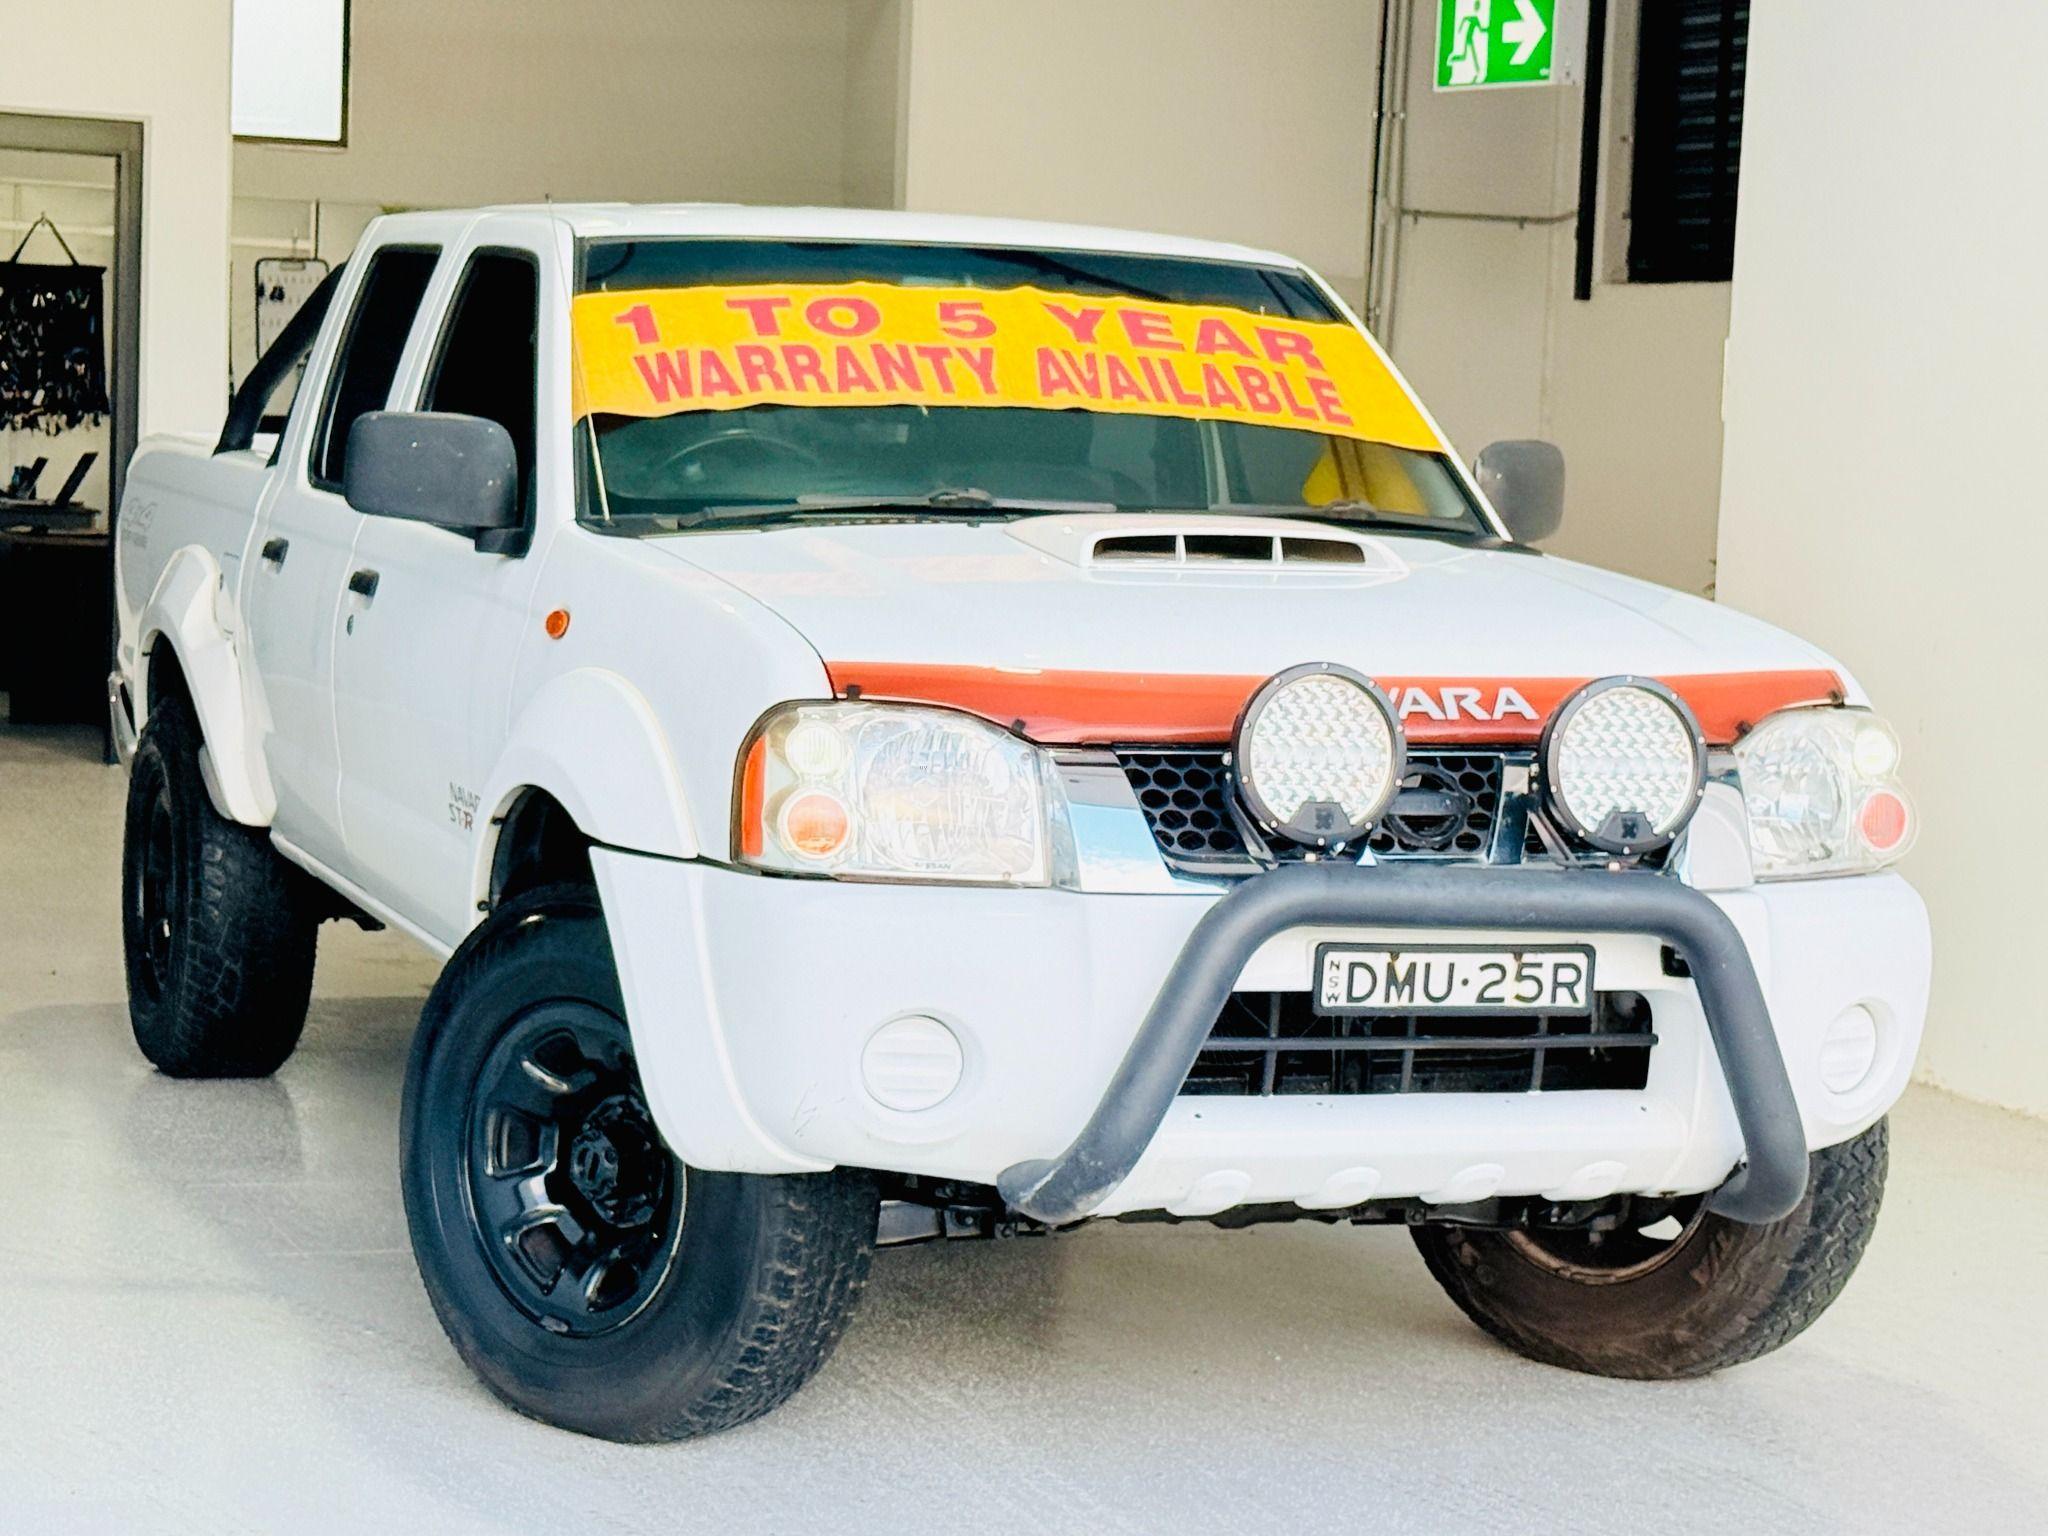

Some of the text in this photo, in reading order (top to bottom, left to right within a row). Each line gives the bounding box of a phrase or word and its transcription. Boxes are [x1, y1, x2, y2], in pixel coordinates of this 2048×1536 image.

[615, 298, 1327, 372] 1 TO 5 YEAR
[633, 343, 1355, 427] WARRANTY AVAILABLE
